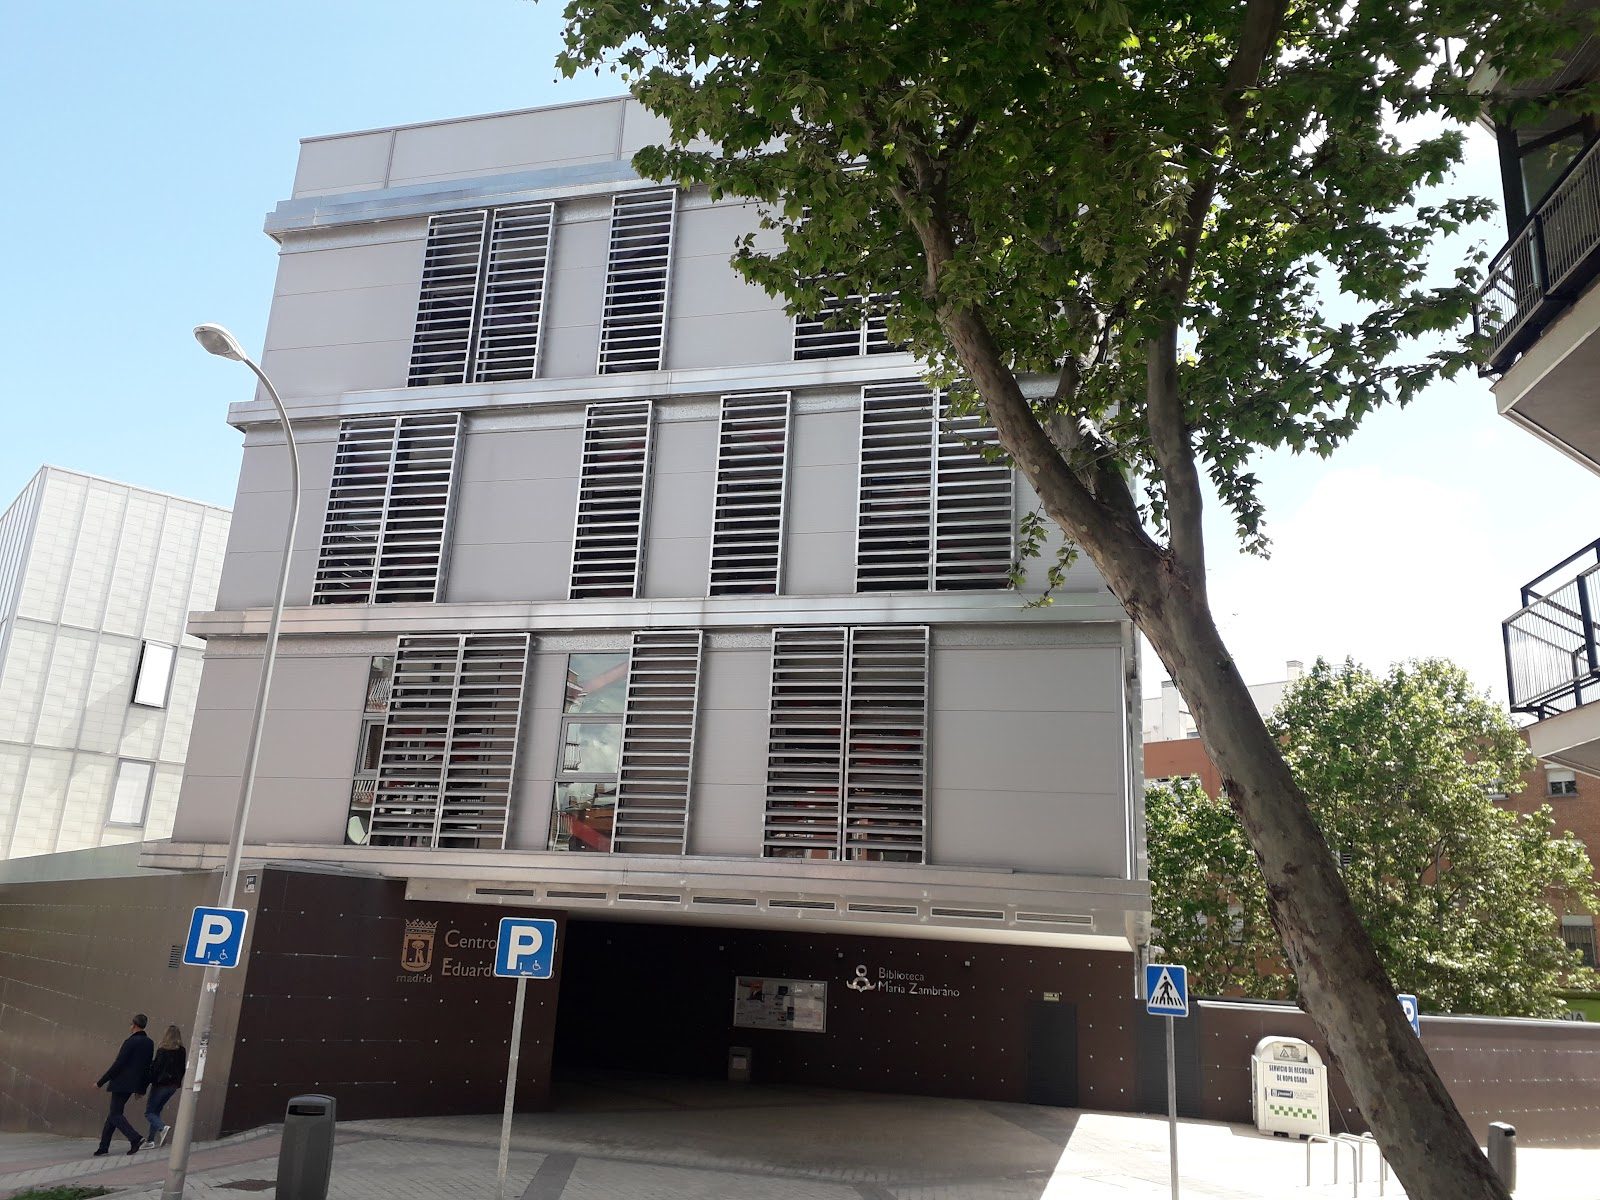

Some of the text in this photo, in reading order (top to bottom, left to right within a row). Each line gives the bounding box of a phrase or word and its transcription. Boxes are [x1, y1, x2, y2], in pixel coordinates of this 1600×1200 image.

[195, 914, 233, 958] P
[444, 929, 498, 950] Centro
[506, 925, 543, 970] P
[396, 973, 433, 983] madrid
[878, 966, 925, 981] Biblioteca
[908, 982, 960, 997] Zambrano
[1269, 1065, 1288, 1073] SERVICIO
[1294, 1066, 1315, 1075] RECOGIDA
